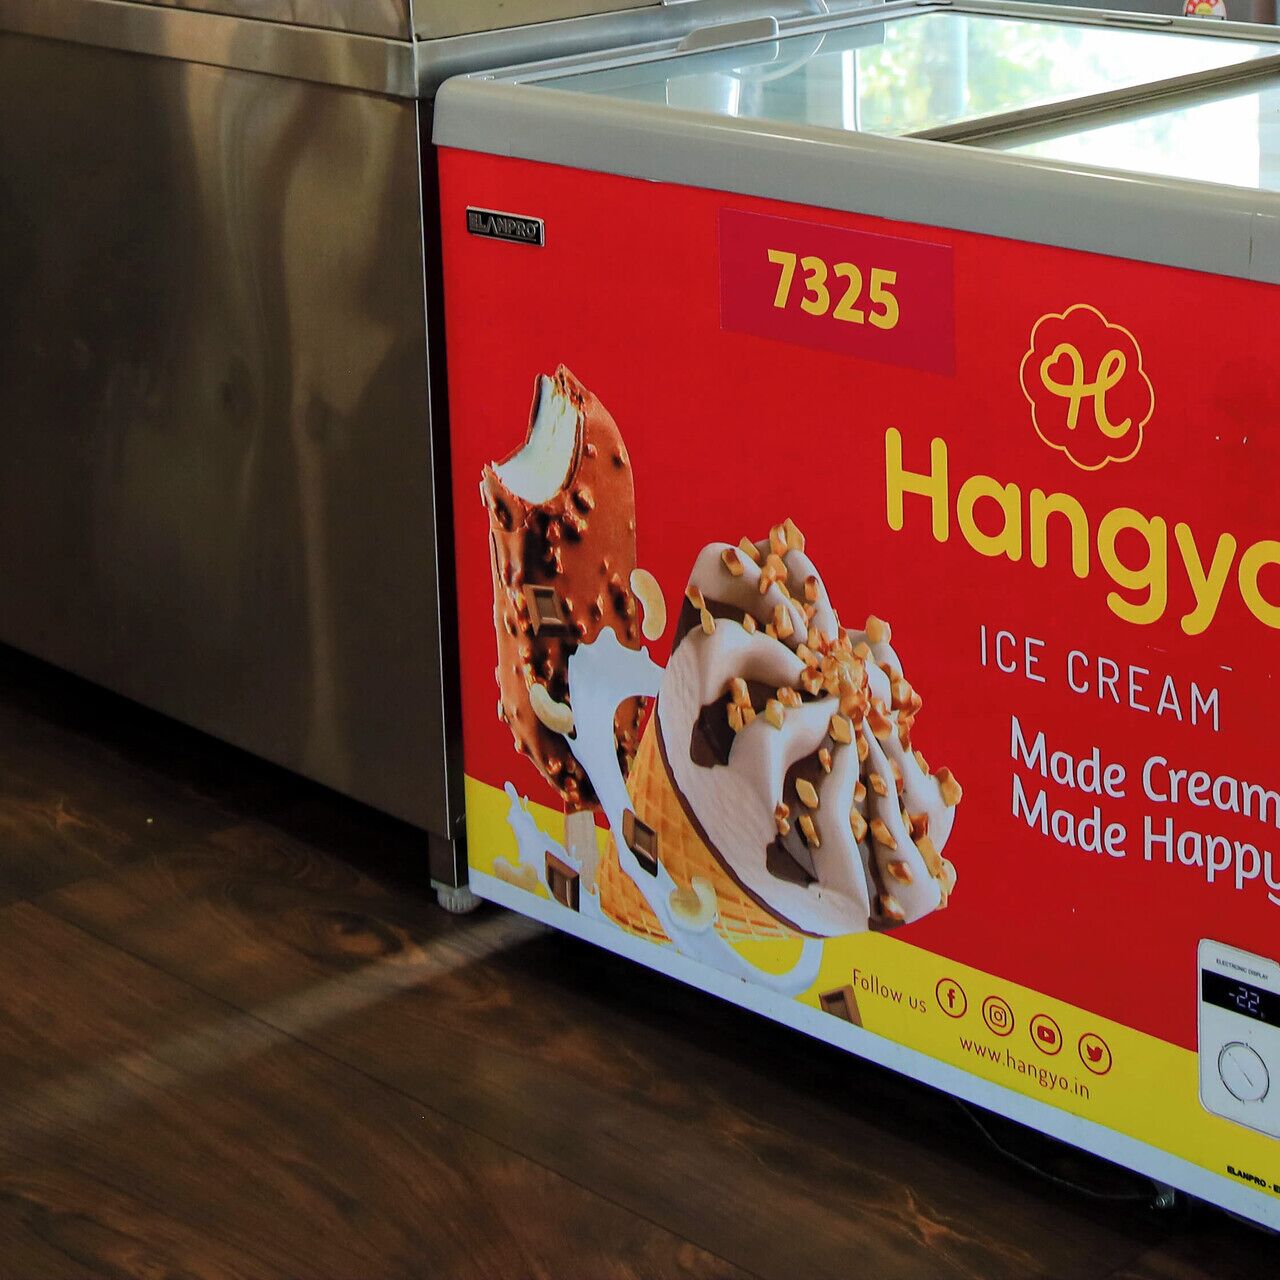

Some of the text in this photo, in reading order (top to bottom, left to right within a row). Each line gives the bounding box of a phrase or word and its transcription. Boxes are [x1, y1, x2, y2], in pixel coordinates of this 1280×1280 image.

[767, 249, 900, 330] 7325
[980, 624, 1220, 732] ICE CREAM
[1011, 715, 1126, 798] Made
[1012, 773, 1128, 858] Made
[852, 968, 927, 1013] Follow us
[1228, 986, 1260, 1013] -22
[959, 1036, 1090, 1100] www.hangyo.in
[1227, 1165, 1267, 1188] ELANPRO
